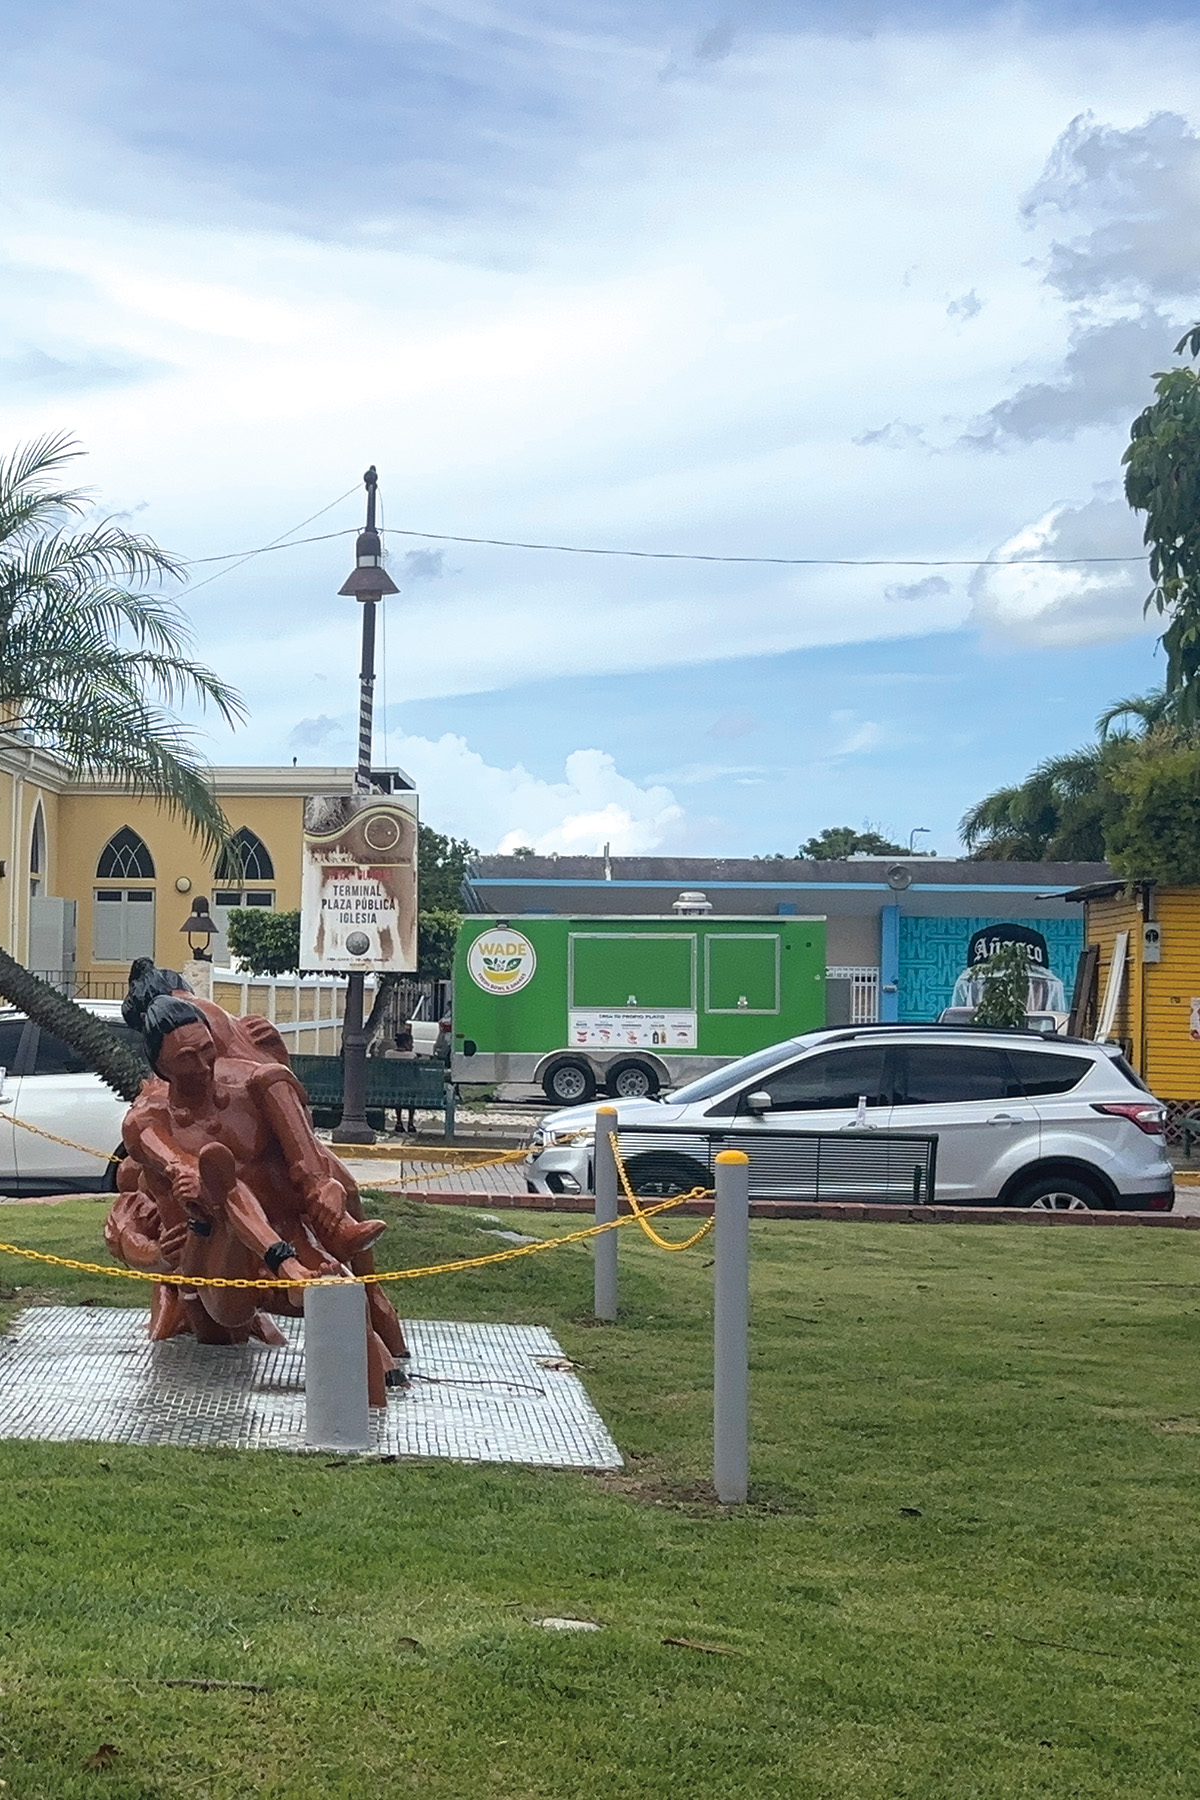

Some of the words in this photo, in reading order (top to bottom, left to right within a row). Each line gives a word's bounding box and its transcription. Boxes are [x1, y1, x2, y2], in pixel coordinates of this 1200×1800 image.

[333, 885, 381, 896] TERMINAL
[322, 899, 352, 910] PLAZA
[355, 897, 395, 910] PÚBLICA
[340, 913, 377, 924] IGLESIA
[478, 943, 527, 956] WADE
